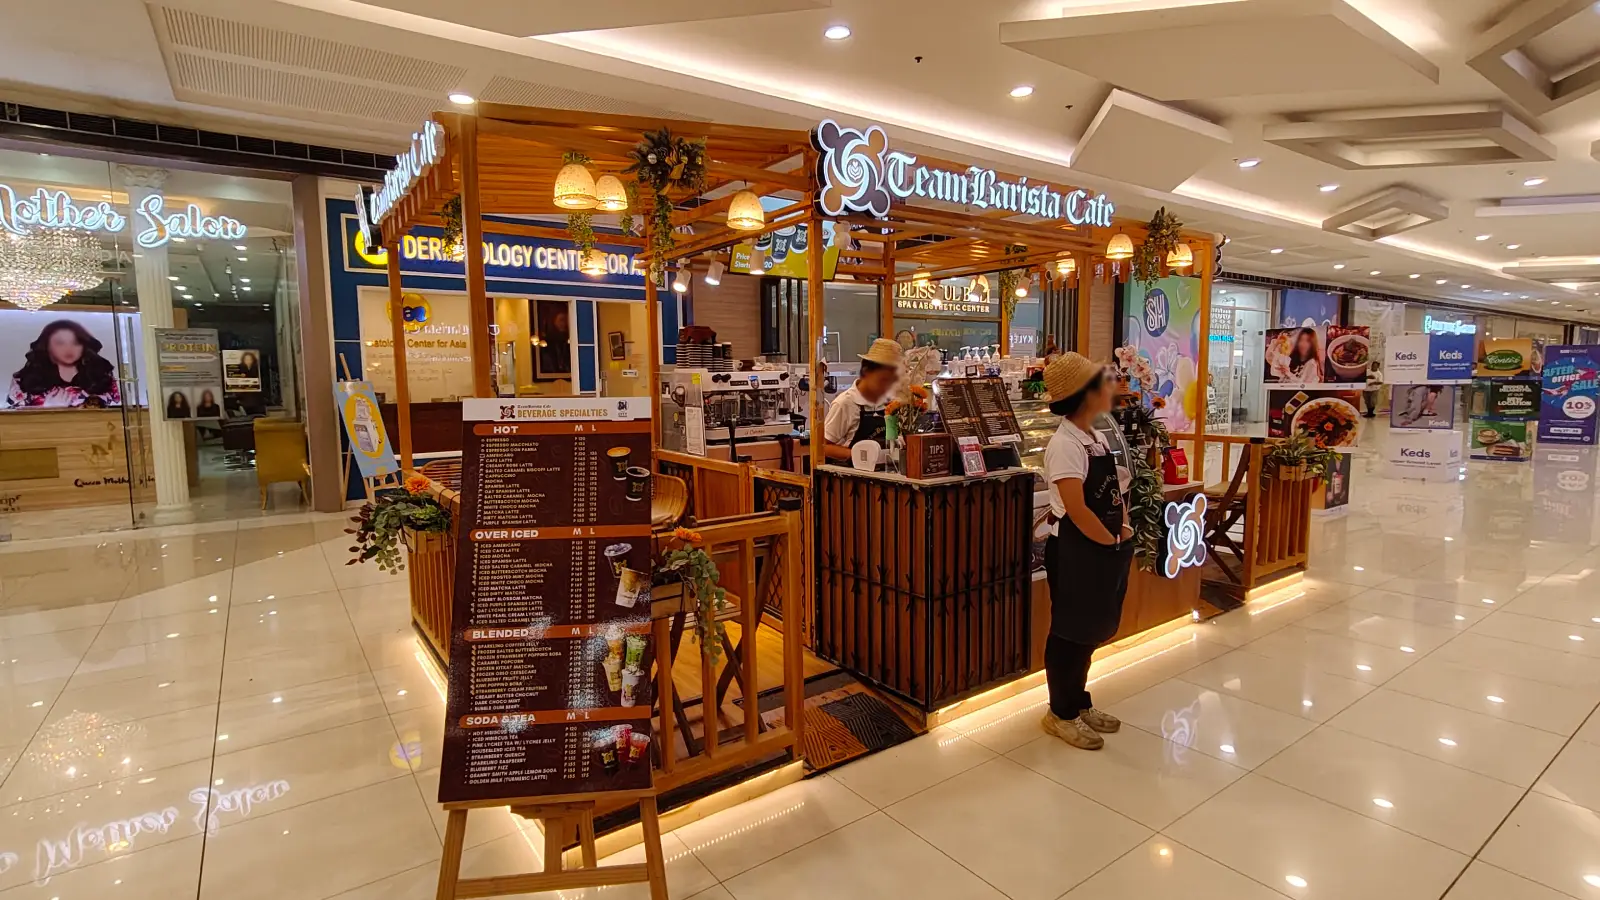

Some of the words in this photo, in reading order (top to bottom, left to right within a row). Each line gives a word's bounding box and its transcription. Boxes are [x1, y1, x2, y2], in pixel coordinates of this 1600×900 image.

[1065, 189, 1116, 228] Cafe
[137, 194, 248, 248] Salon
[535, 246, 586, 271] CENTE
[899, 281, 961, 300] BLISSUL
[963, 286, 990, 303] BLI
[898, 300, 912, 308] SPA
[962, 304, 990, 312] CENTER
[407, 338, 435, 348] Center
[450, 340, 467, 348] Asia
[1396, 352, 1418, 360] Keds
[1440, 350, 1463, 360] Keds
[1552, 374, 1580, 383] OFFICE
[1572, 380, 1599, 390] SALE
[518, 410, 556, 418] BEVERAGE
[560, 409, 608, 417] SPECIALTIES
[930, 444, 944, 454] TIPS
[1401, 448, 1430, 458] Keds
[475, 531, 508, 539] OVER
[511, 530, 539, 538] ICED
[472, 630, 529, 638] BLENDED
[466, 716, 498, 725] SODA
[513, 714, 536, 722] TEA
